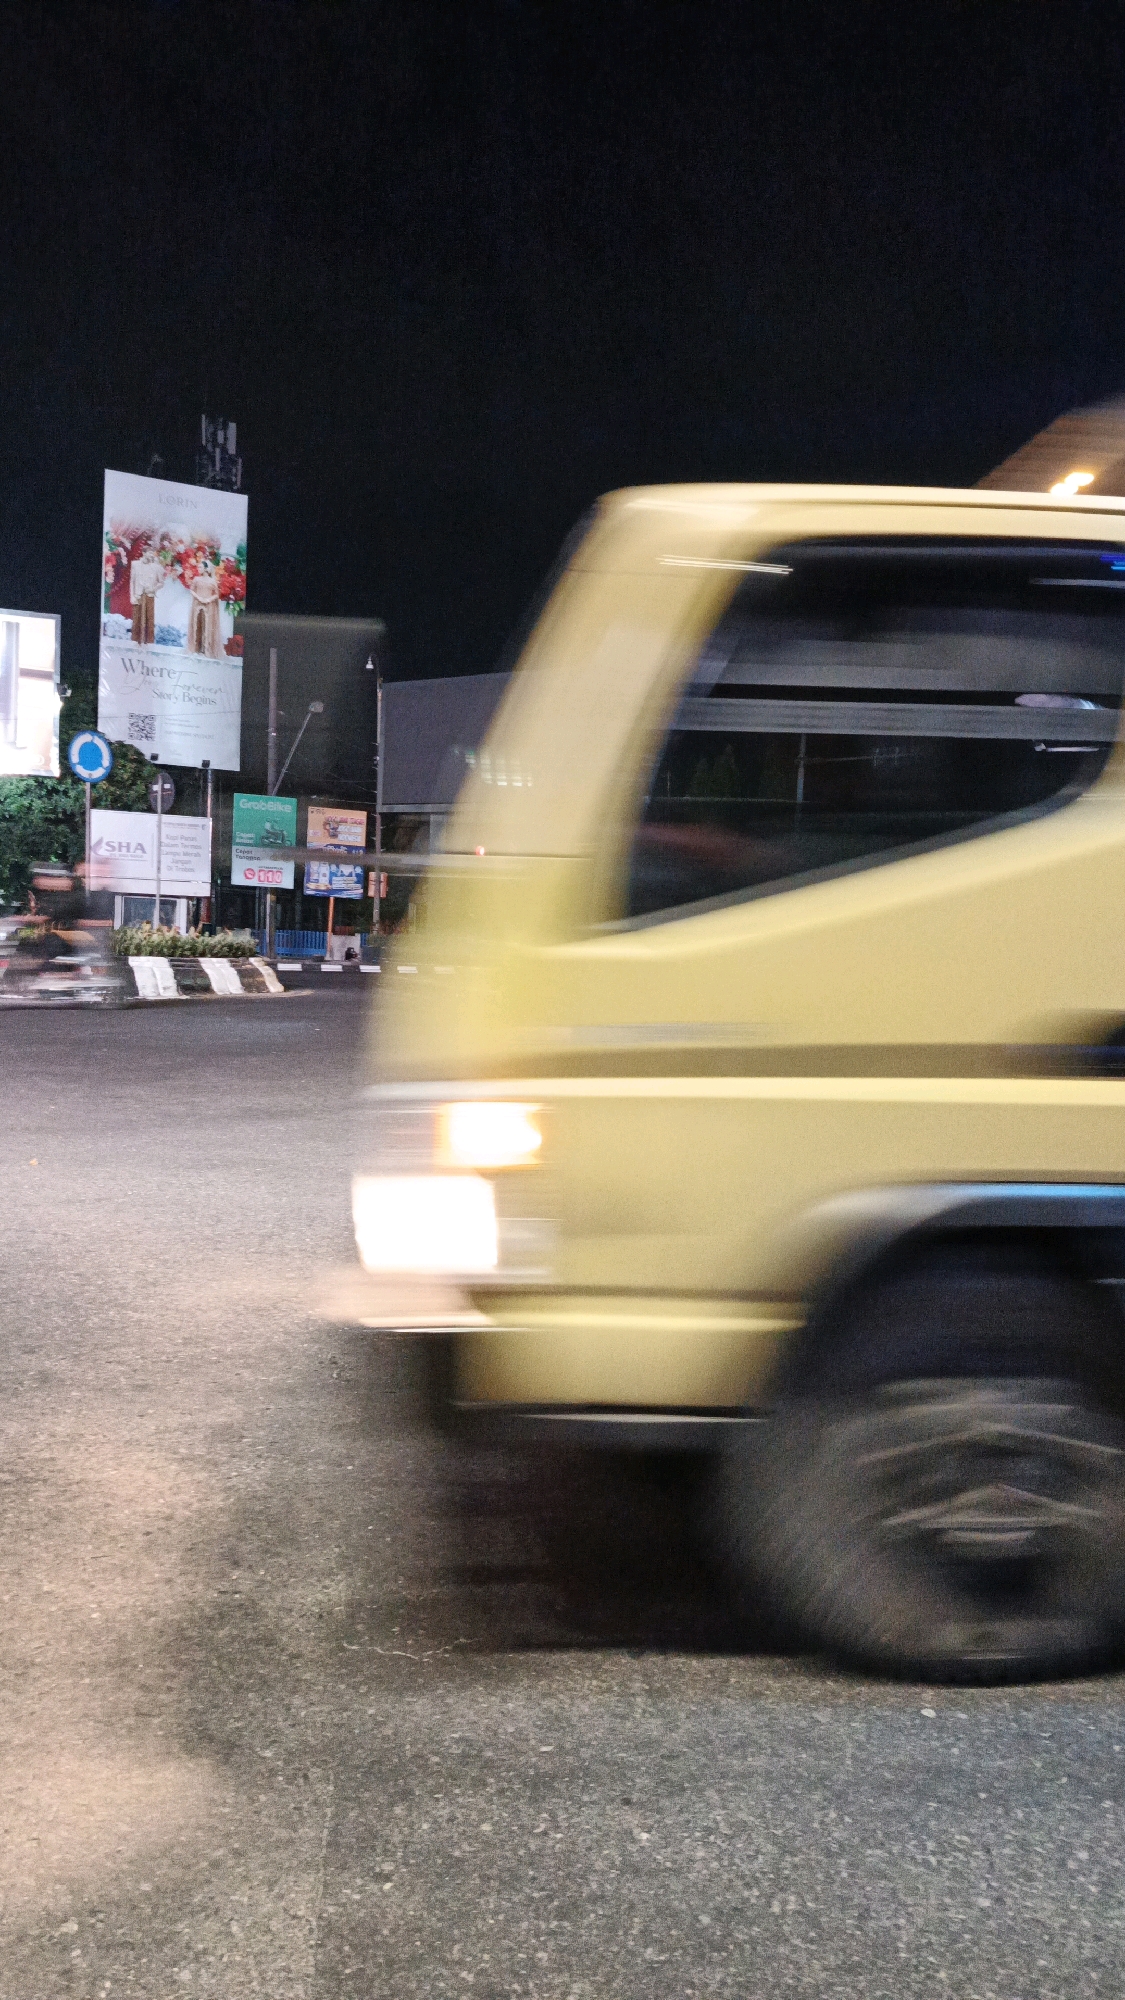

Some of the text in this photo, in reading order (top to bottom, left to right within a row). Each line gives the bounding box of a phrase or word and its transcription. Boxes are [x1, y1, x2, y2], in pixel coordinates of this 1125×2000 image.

[158, 493, 199, 510] LORIN
[121, 657, 177, 680] Where
[152, 688, 217, 706] Story Begins
[239, 799, 292, 813] GrabBike
[105, 840, 147, 854] SHA
[259, 869, 283, 884] 110
